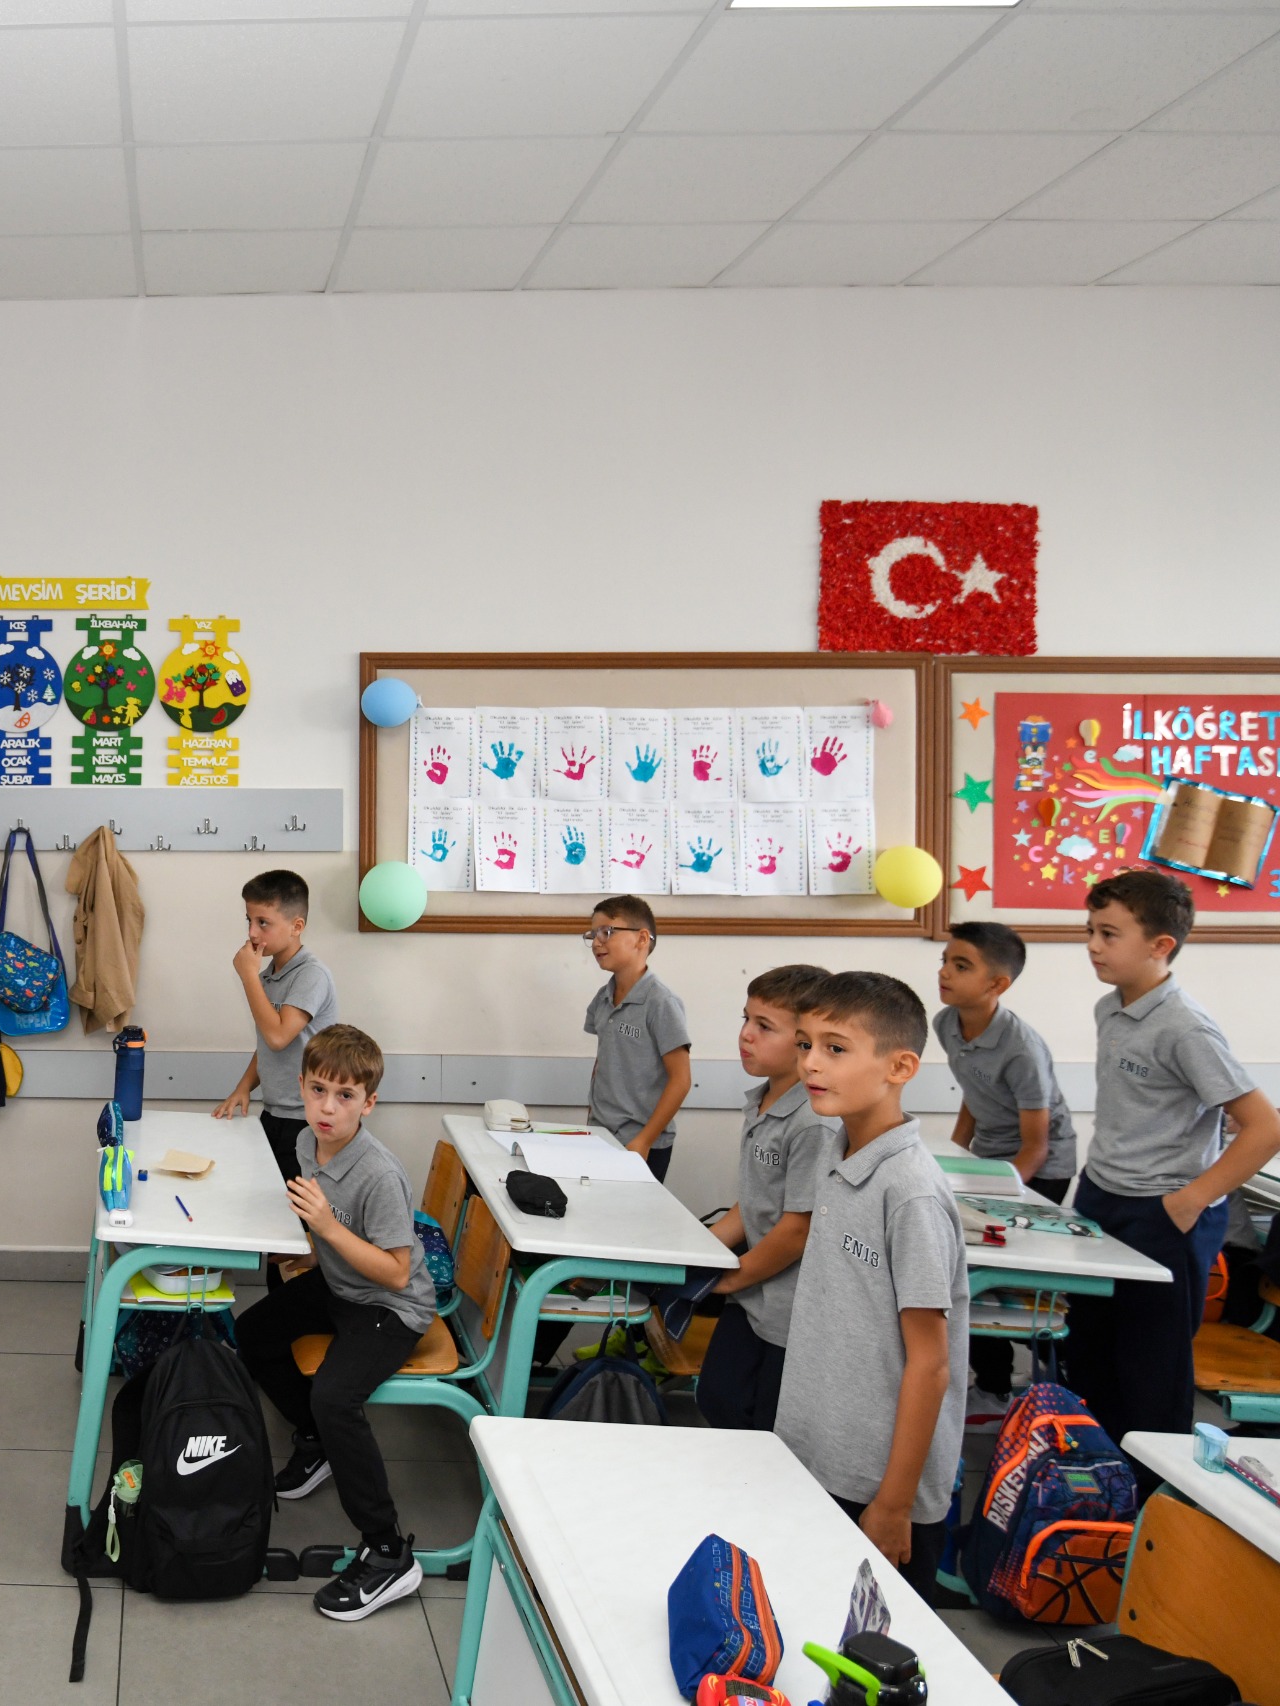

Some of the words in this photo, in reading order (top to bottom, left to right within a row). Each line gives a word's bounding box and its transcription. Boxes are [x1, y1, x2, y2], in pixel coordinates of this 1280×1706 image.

[75, 579, 136, 604] ŞERİDİ
[9, 621, 27, 632] KIŞ
[89, 618, 138, 630] İLKBAHAR
[195, 621, 212, 630] YAZ
[0, 738, 40, 749] ARALIK
[92, 737, 123, 747] MART
[182, 737, 232, 749] HAZİRAN
[1, 756, 31, 767] OCAK
[92, 754, 127, 765] NİSAN
[181, 757, 228, 767] TEMMUZ
[0, 774, 34, 786] ŞUBAT
[91, 773, 126, 785] MAYIS
[180, 772, 229, 785] AĞUSTOS
[1098, 829, 1111, 844] E
[754, 1143, 781, 1167] EN18
[328, 1202, 352, 1226] N18
[841, 1232, 880, 1268] EN18
[184, 1435, 227, 1458] NIKE
